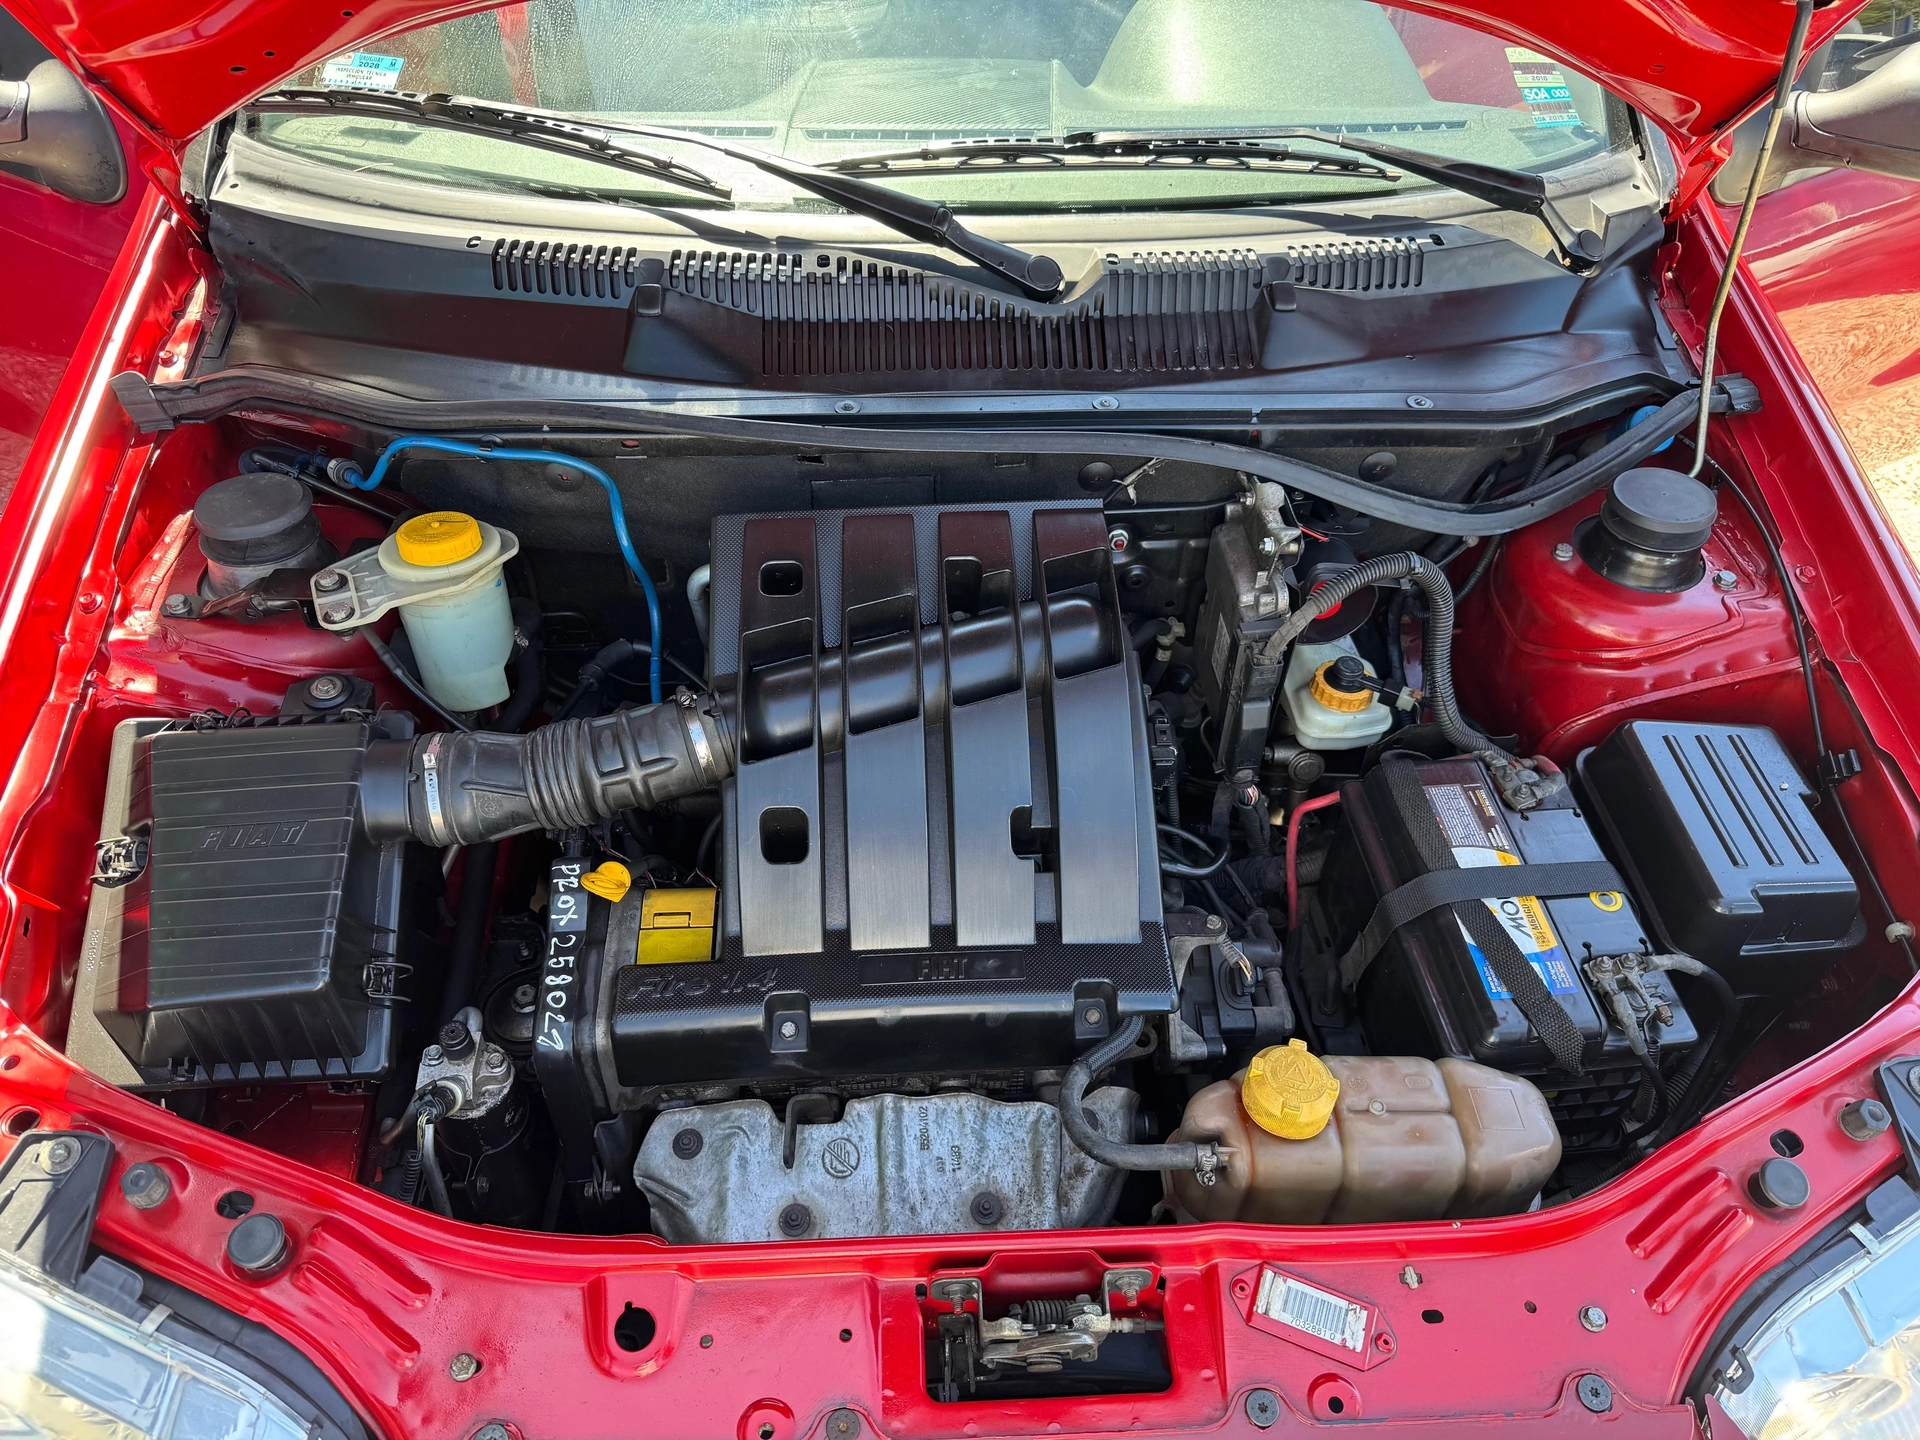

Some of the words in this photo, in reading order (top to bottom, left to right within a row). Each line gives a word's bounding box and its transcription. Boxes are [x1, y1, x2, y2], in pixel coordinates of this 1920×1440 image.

[358, 61, 380, 69] 2028
[1523, 89, 1551, 100] SOA
[199, 824, 301, 849] FIAT
[1497, 897, 1533, 939] MO
[720, 967, 779, 993] 1.4
[917, 957, 968, 980] FIAT
